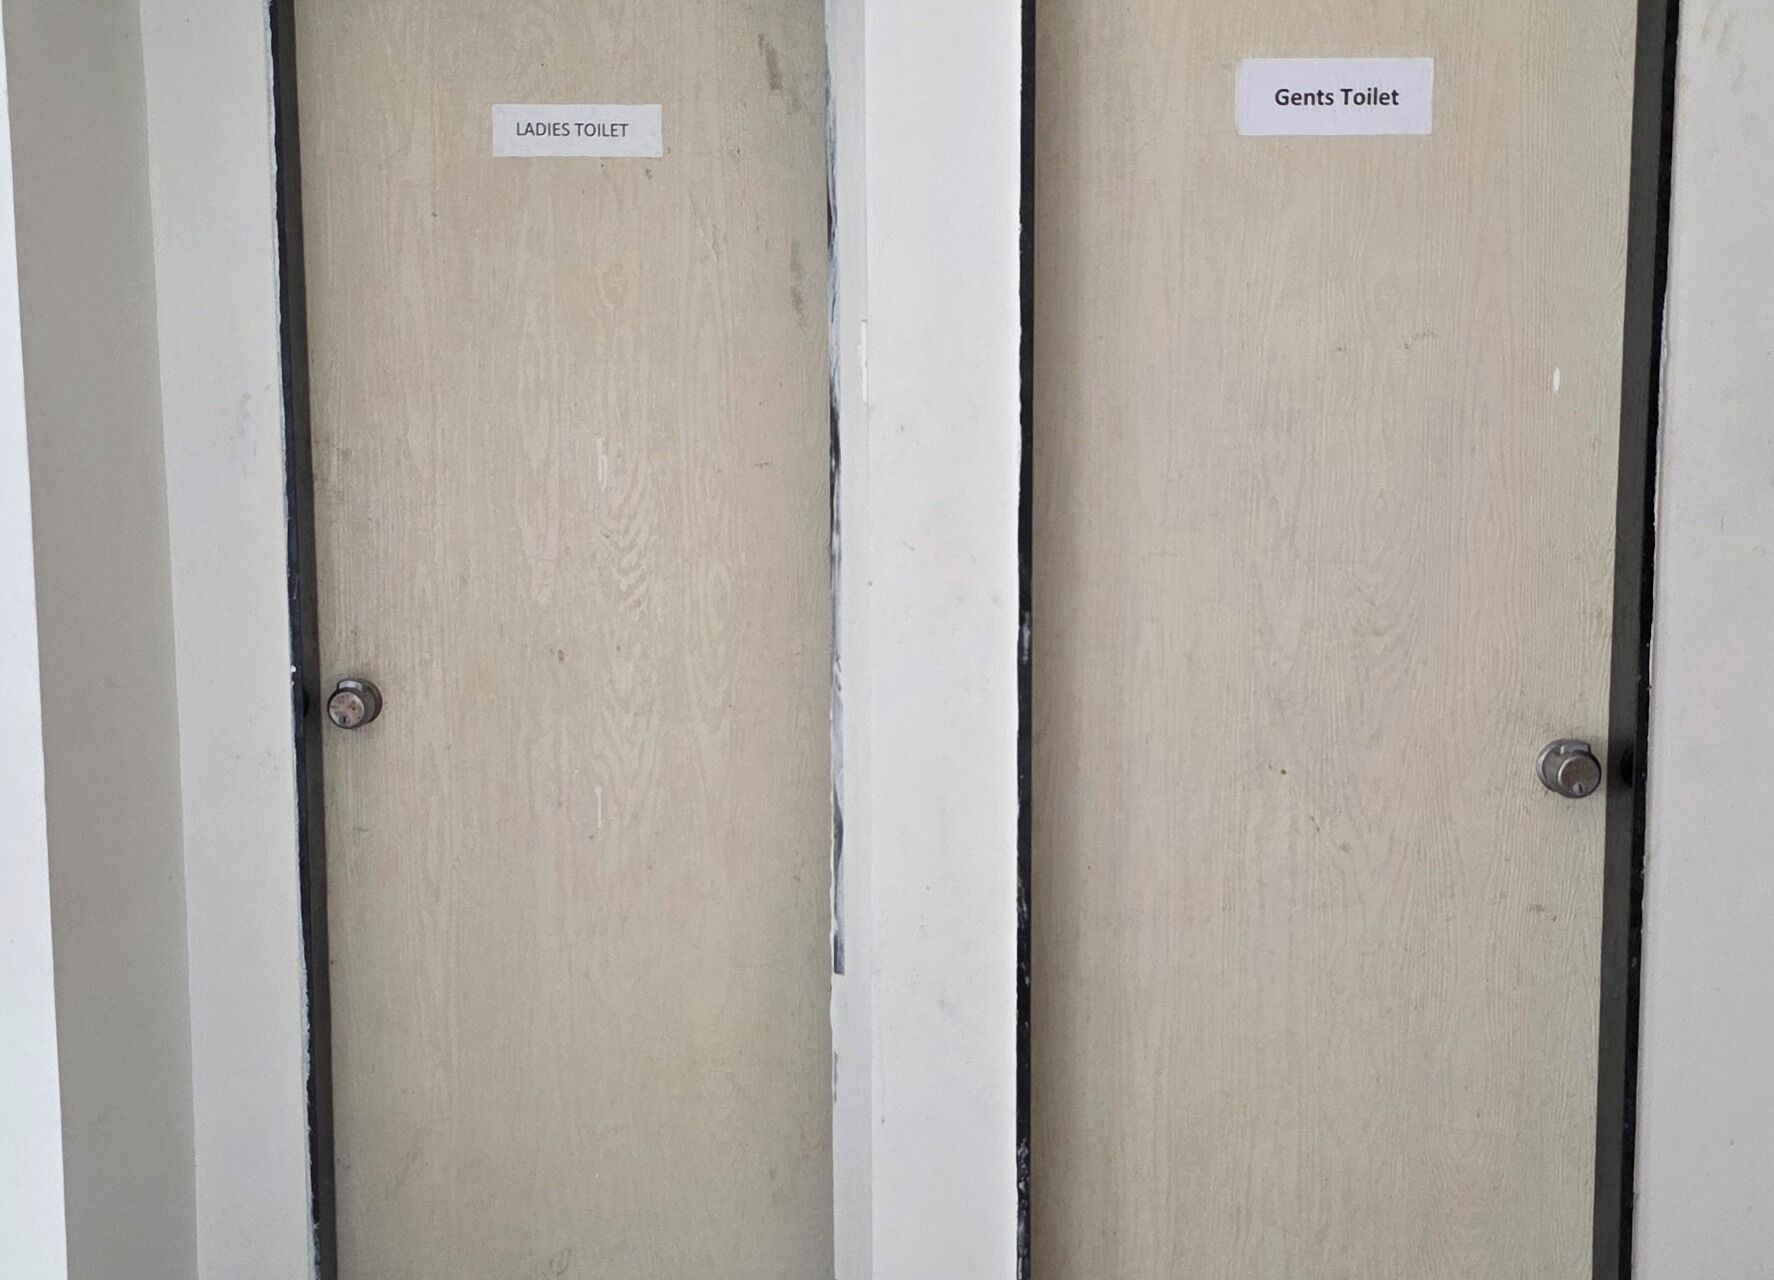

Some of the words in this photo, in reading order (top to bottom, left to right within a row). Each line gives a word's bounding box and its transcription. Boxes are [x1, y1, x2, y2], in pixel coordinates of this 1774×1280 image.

[1274, 88, 1335, 106] Gents
[1340, 86, 1400, 106] Toilet
[516, 122, 571, 137] LADIES
[574, 123, 629, 138] TOILET
